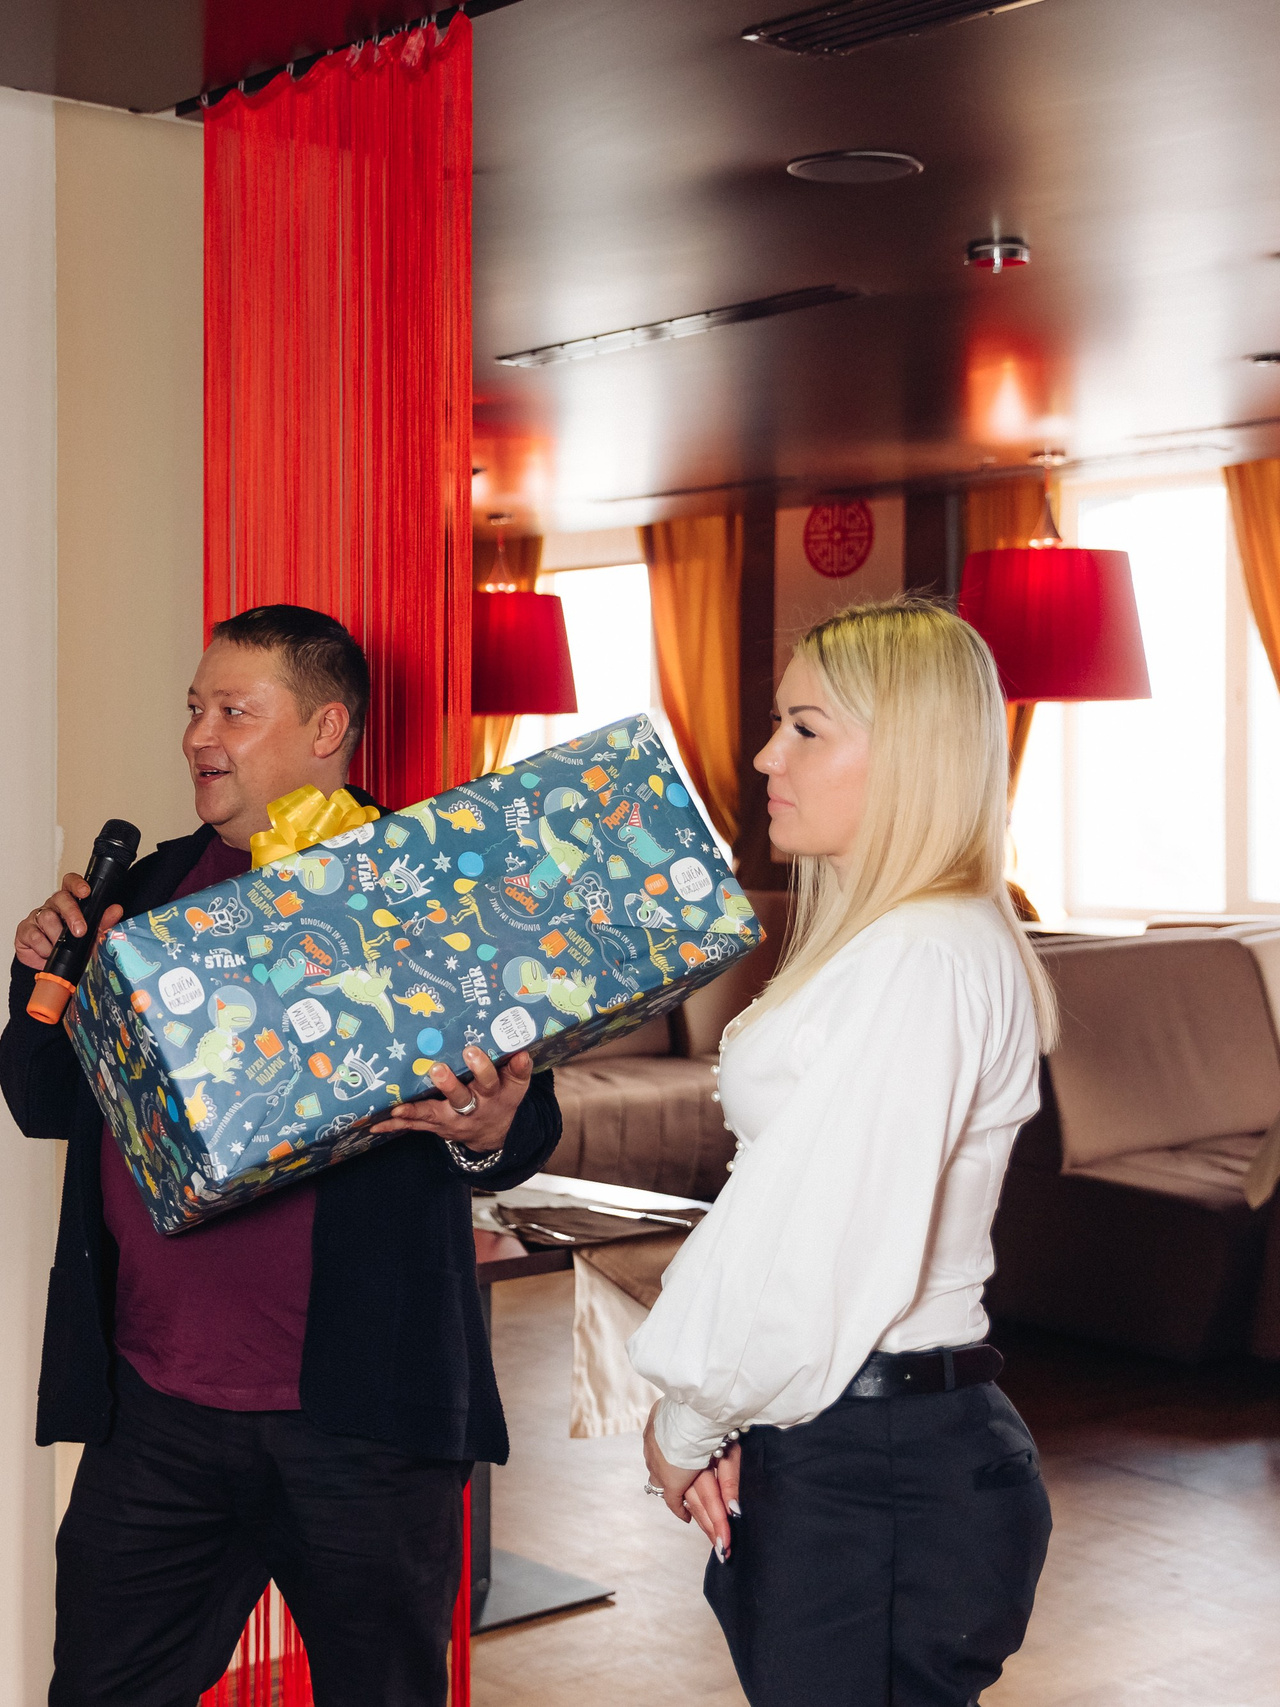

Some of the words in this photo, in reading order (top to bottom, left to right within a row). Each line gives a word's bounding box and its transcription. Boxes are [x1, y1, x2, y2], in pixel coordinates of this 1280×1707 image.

[513, 797, 530, 828] TAR
[683, 866, 704, 883] ДНЁМ
[246, 888, 277, 919] ПОДАРОК
[489, 897, 502, 914] SPACE
[300, 917, 333, 934] DINOSAURS
[337, 938, 350, 955] SPACE
[508, 919, 541, 932] DINOSAURS
[596, 923, 622, 938] NOSAURS
[564, 927, 595, 957] ПОДАРОК
[172, 976, 196, 996] ДНЁМ
[468, 965, 491, 1006] STAR
[291, 1007, 314, 1031] ДНЁМ
[499, 1015, 520, 1040] ДНЁМ
[255, 1056, 286, 1086] ПОДАРОК
